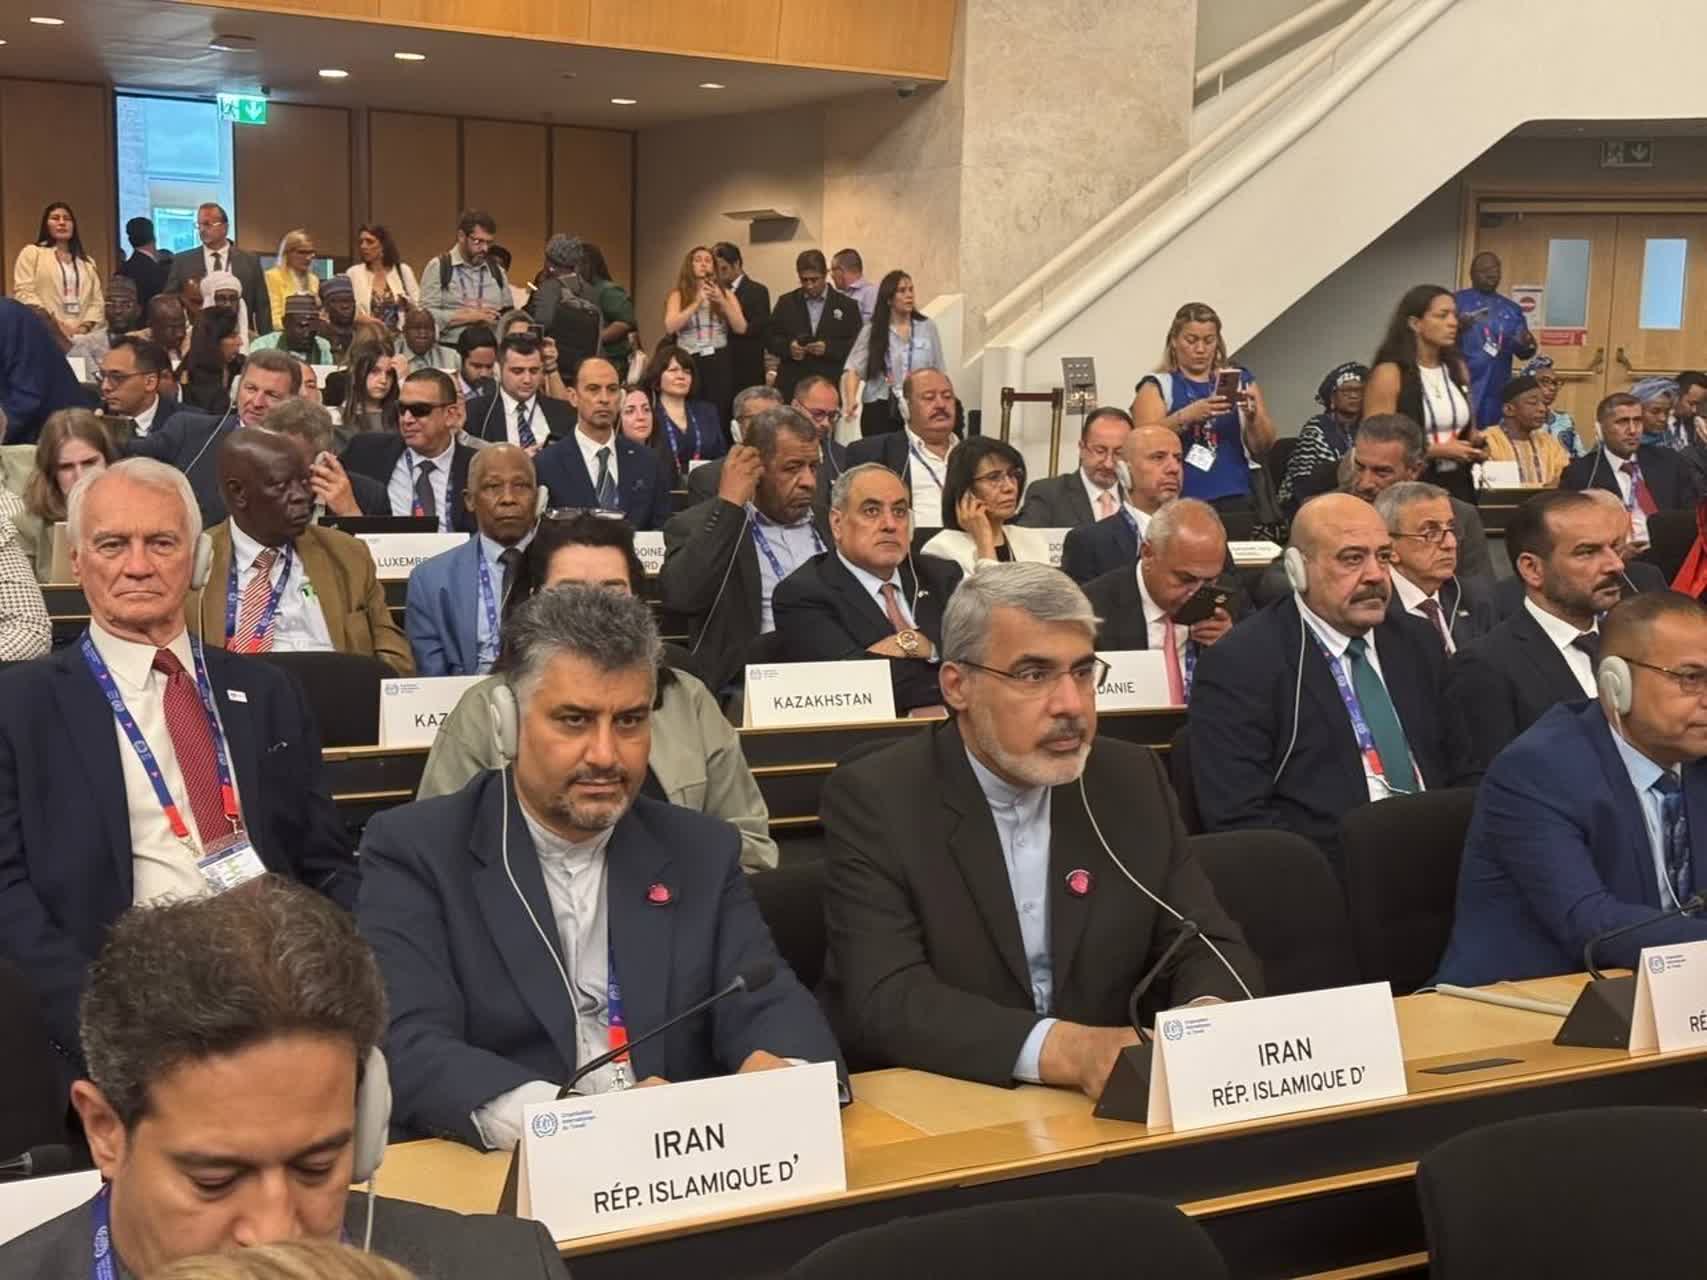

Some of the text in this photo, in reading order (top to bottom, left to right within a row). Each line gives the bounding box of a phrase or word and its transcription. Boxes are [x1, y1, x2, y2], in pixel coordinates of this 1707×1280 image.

[773, 692, 872, 710] KAZAKHSTAN
[1257, 1036, 1313, 1067] IRAN
[1212, 1081, 1249, 1107] RÉP.
[1253, 1068, 1347, 1101] ISLAMIQUE
[654, 1122, 725, 1159] IRAN
[593, 1181, 643, 1214] RÉP.
[649, 1163, 773, 1204] ISLAMIQUE
